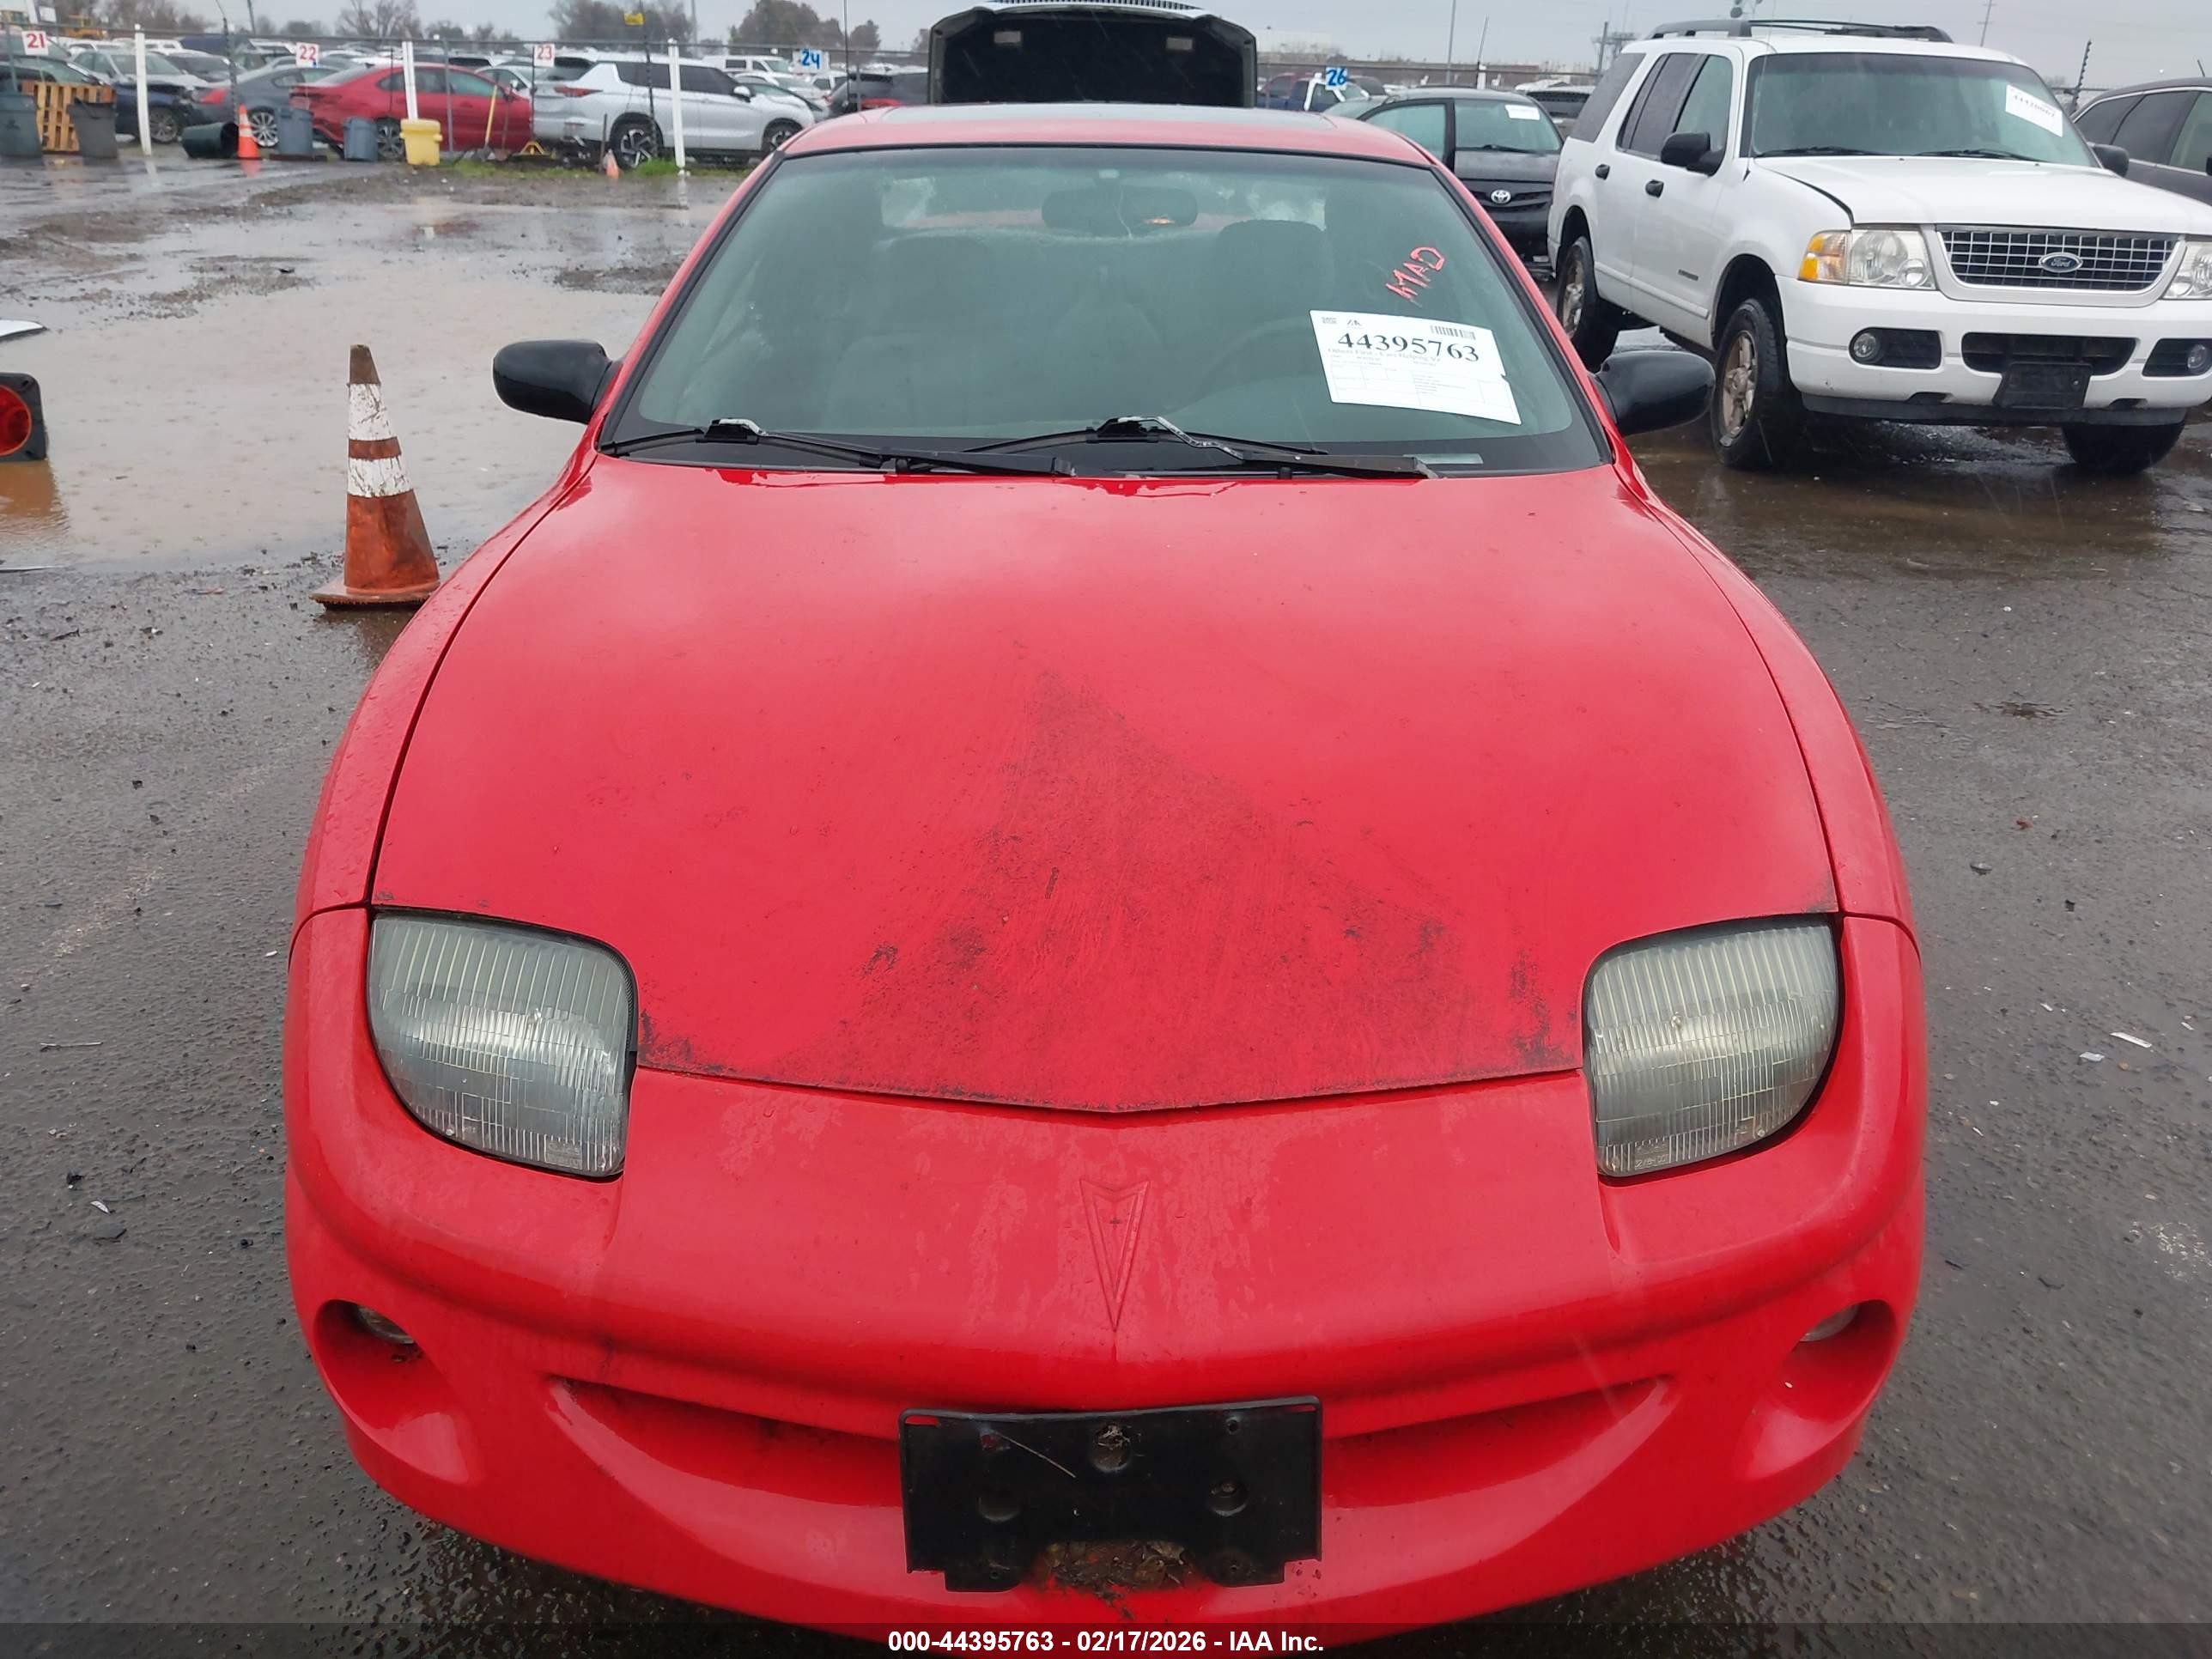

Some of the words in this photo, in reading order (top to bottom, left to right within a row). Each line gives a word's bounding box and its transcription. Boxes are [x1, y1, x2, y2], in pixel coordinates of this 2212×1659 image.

[27, 33, 46, 49] 21
[300, 45, 317, 60] 22
[537, 45, 552, 60] 23
[801, 49, 820, 70] 24
[1326, 67, 1347, 86] 26
[1338, 332, 1479, 362] 44395763
